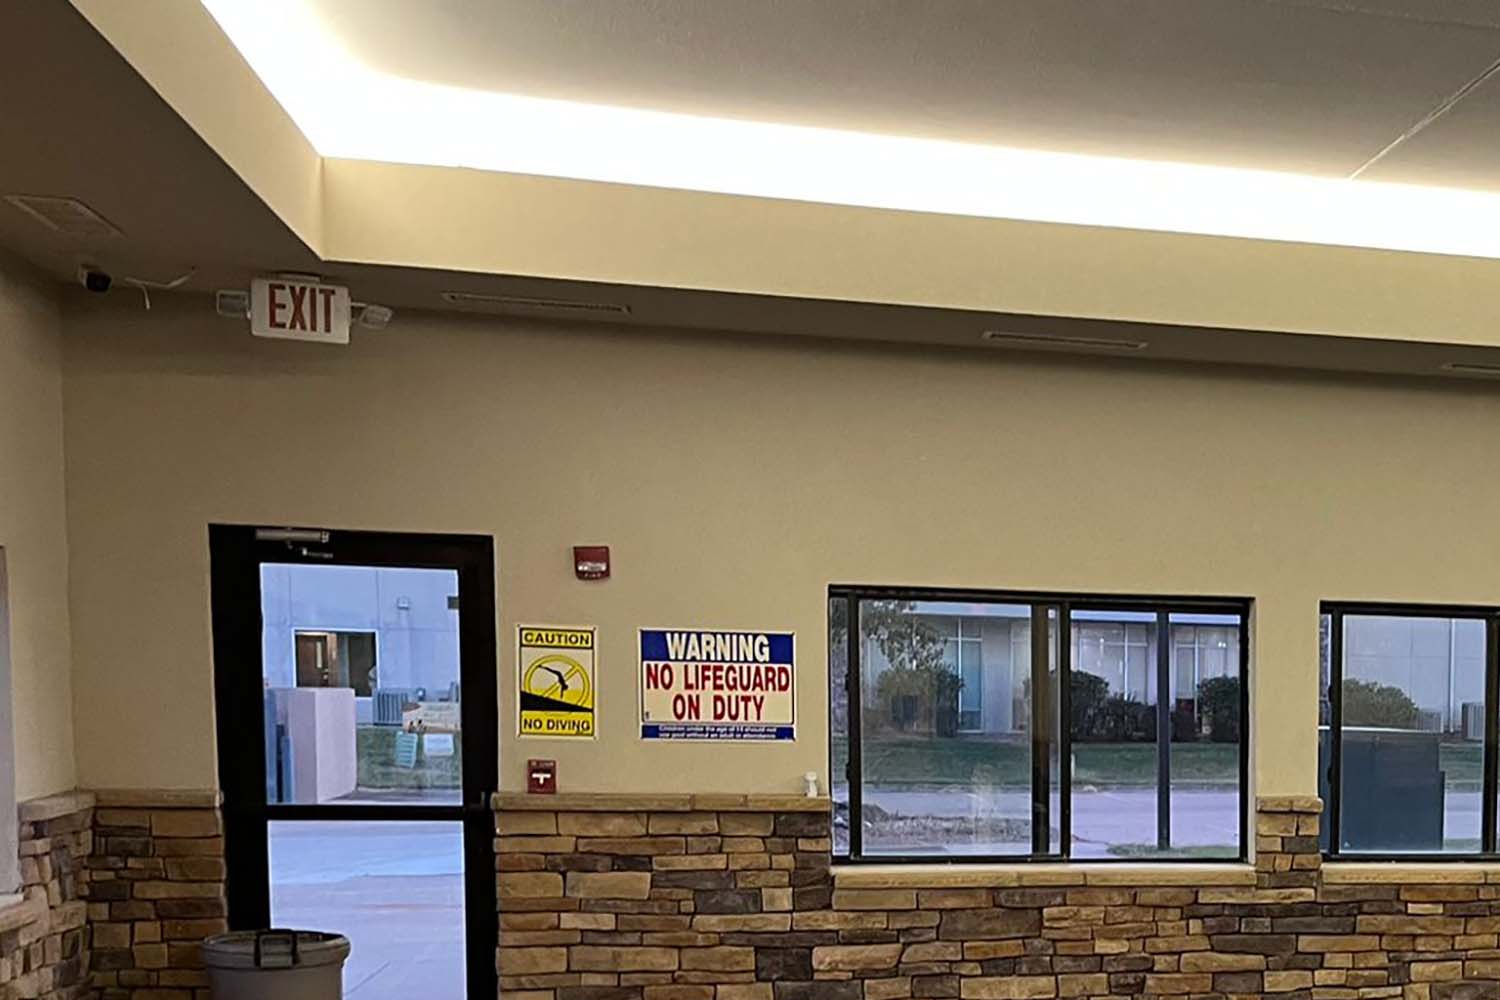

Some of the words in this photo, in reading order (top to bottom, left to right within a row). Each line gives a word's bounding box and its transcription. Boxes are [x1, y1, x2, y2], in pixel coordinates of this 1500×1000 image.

[268, 283, 336, 333] EXIT
[524, 631, 590, 646] CAUTION
[665, 632, 770, 663] WARNING
[646, 663, 674, 690] NO
[683, 664, 790, 692] LIFEGUARD
[672, 694, 701, 721] ON
[712, 695, 765, 721] DUTY
[523, 718, 543, 730] NO
[546, 719, 591, 732] DIVING
